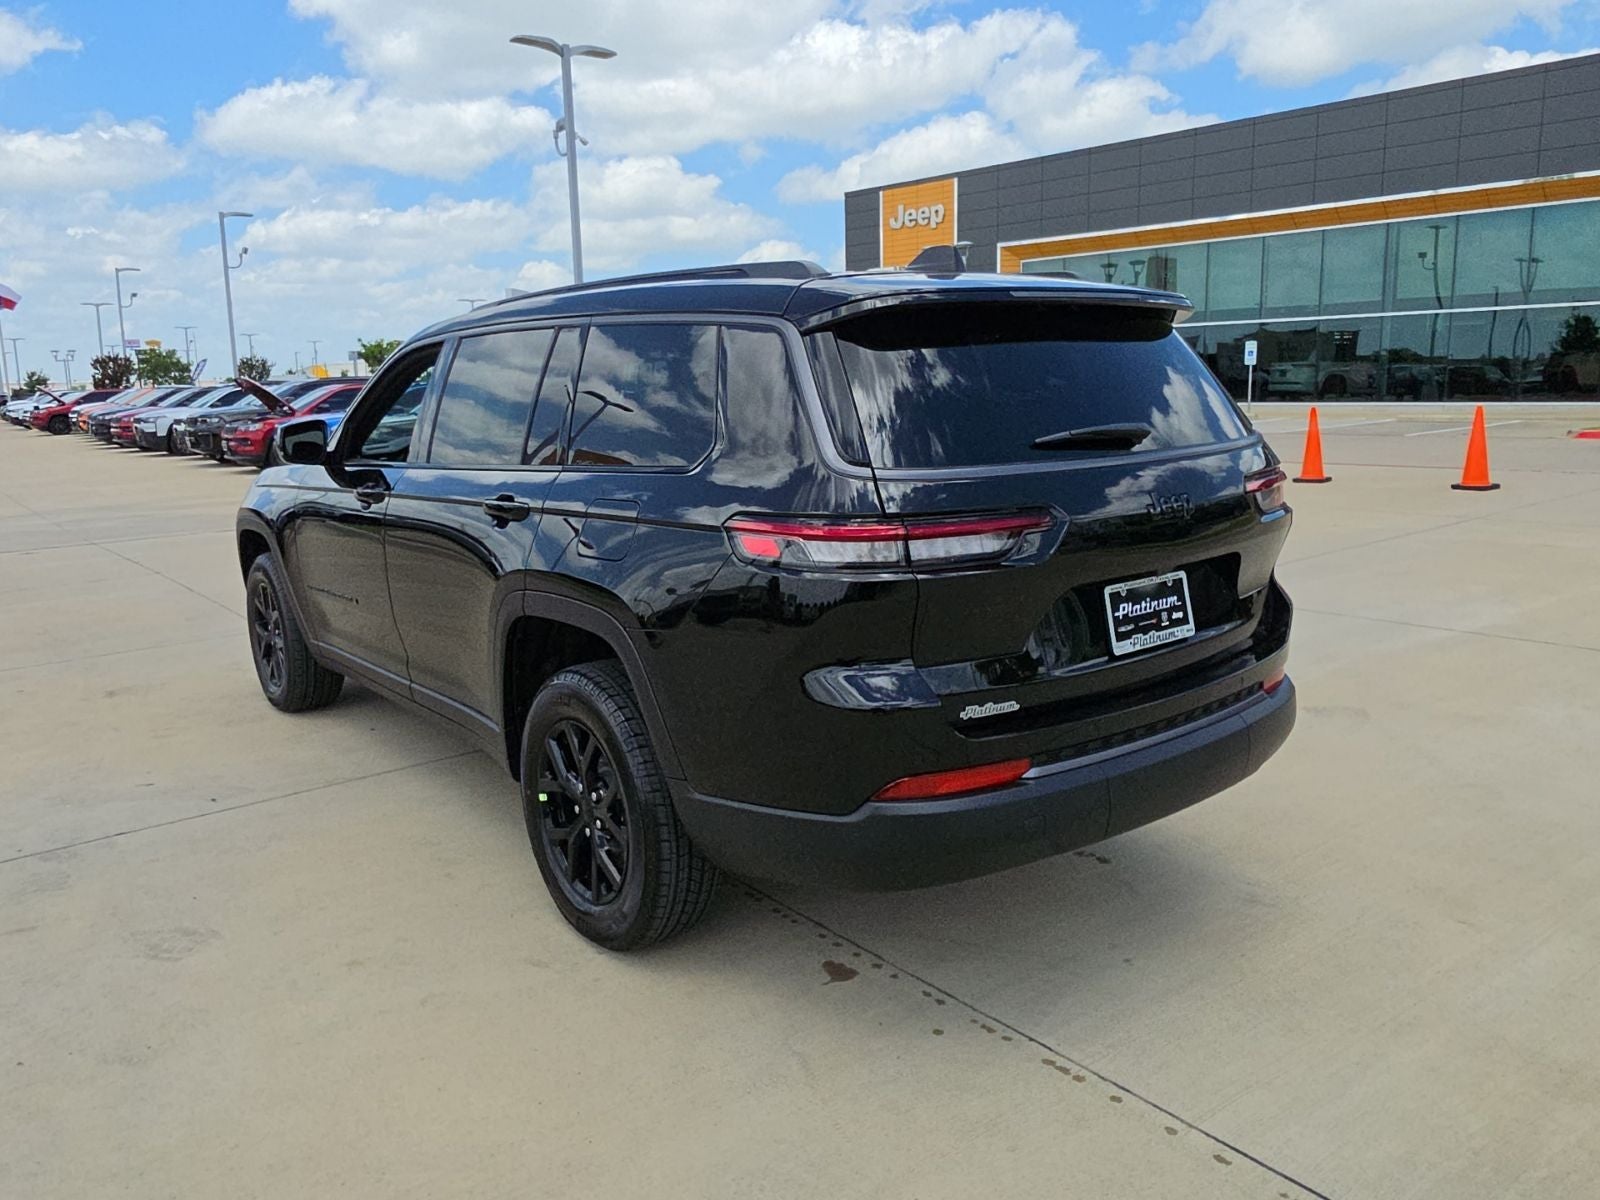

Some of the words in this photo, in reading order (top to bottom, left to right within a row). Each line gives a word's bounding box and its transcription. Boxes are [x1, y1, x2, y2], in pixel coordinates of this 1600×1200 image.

[889, 204, 945, 229] Jeep
[1146, 492, 1195, 519] Jeep
[1114, 596, 1182, 620] Platinum
[1131, 632, 1180, 649] Platinum
[960, 701, 1020, 720] Platinum
